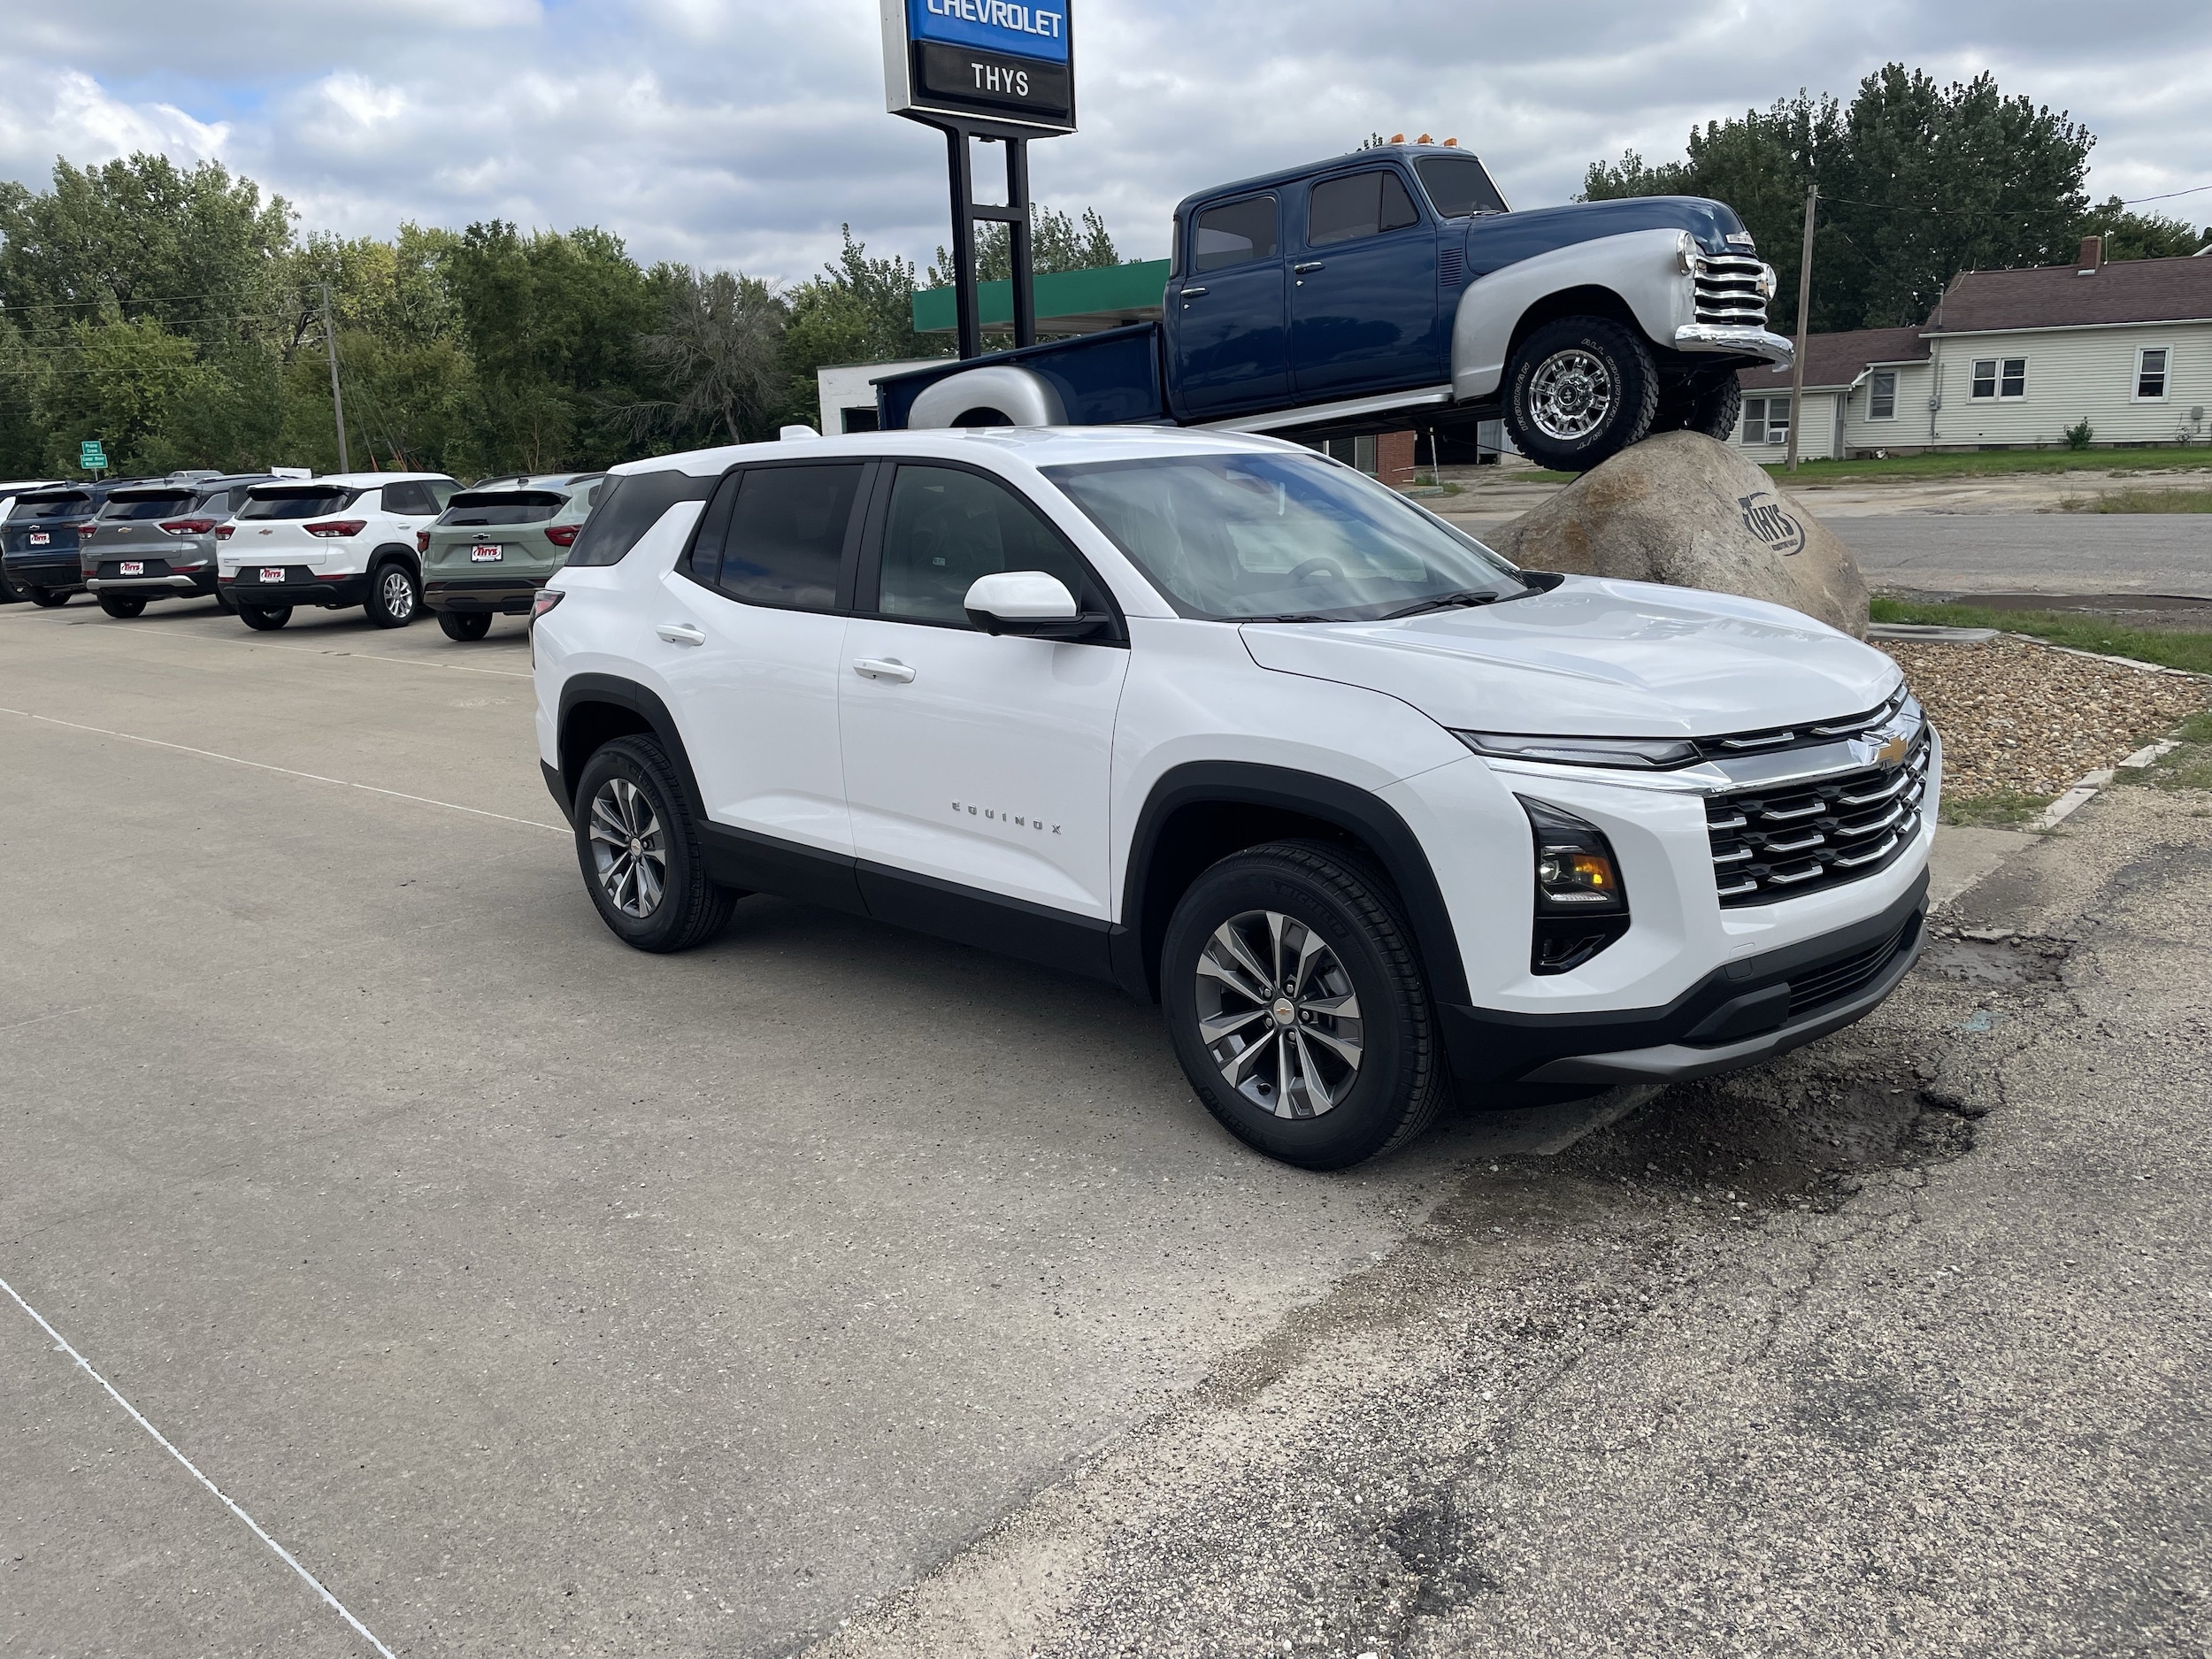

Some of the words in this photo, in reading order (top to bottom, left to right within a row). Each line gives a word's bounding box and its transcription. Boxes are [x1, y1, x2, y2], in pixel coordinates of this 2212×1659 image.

[927, 0, 1062, 38] CHEVROLET
[972, 63, 1029, 96] THYS
[1514, 362, 1530, 431] IRONMAN
[1581, 338, 1604, 355] ALL
[1605, 356, 1622, 427] COUNTRY
[1738, 495, 1794, 541] THYS
[477, 545, 497, 556] THYS
[951, 800, 1062, 834] EQUINOX
[1279, 883, 1347, 936] MICHELIN
